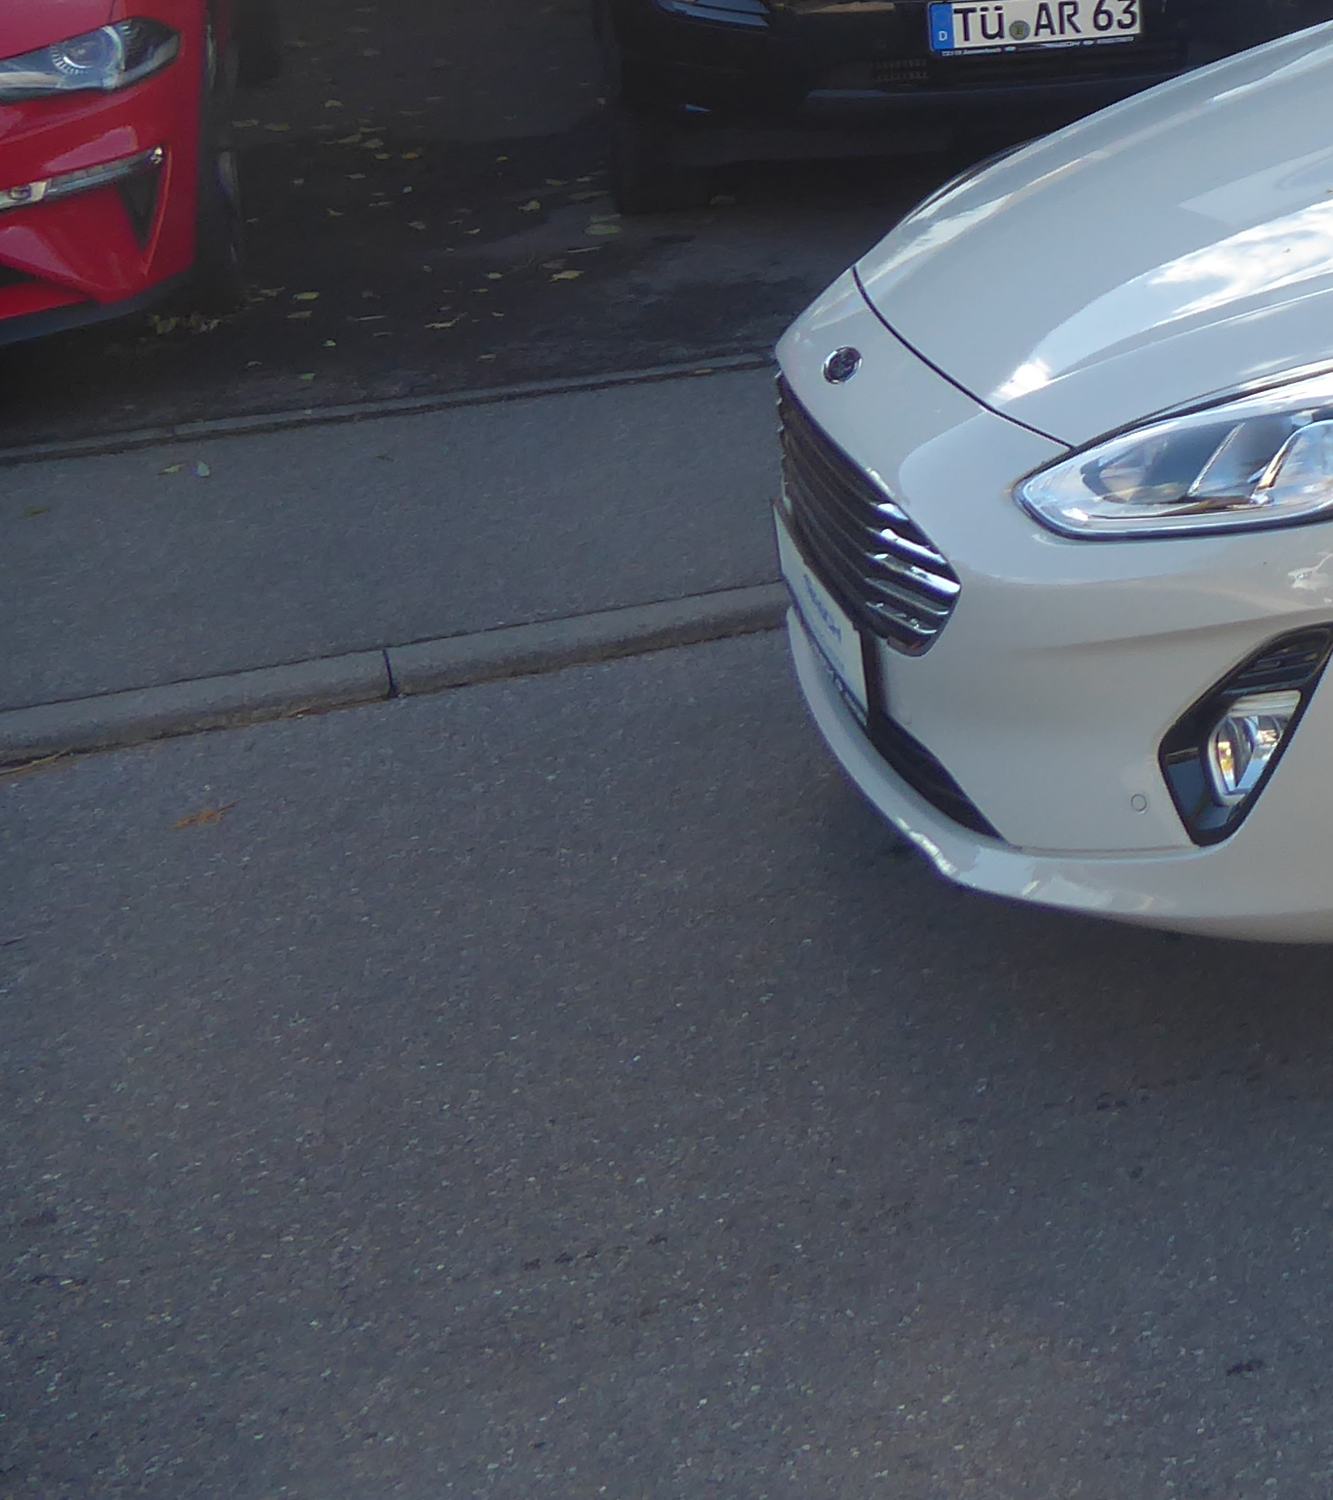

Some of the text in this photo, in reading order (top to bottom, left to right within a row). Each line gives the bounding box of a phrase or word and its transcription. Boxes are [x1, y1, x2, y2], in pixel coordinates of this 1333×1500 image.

[939, 31, 948, 41] D
[953, 5, 1005, 41] TÜ
[1034, 0, 1082, 36] AR
